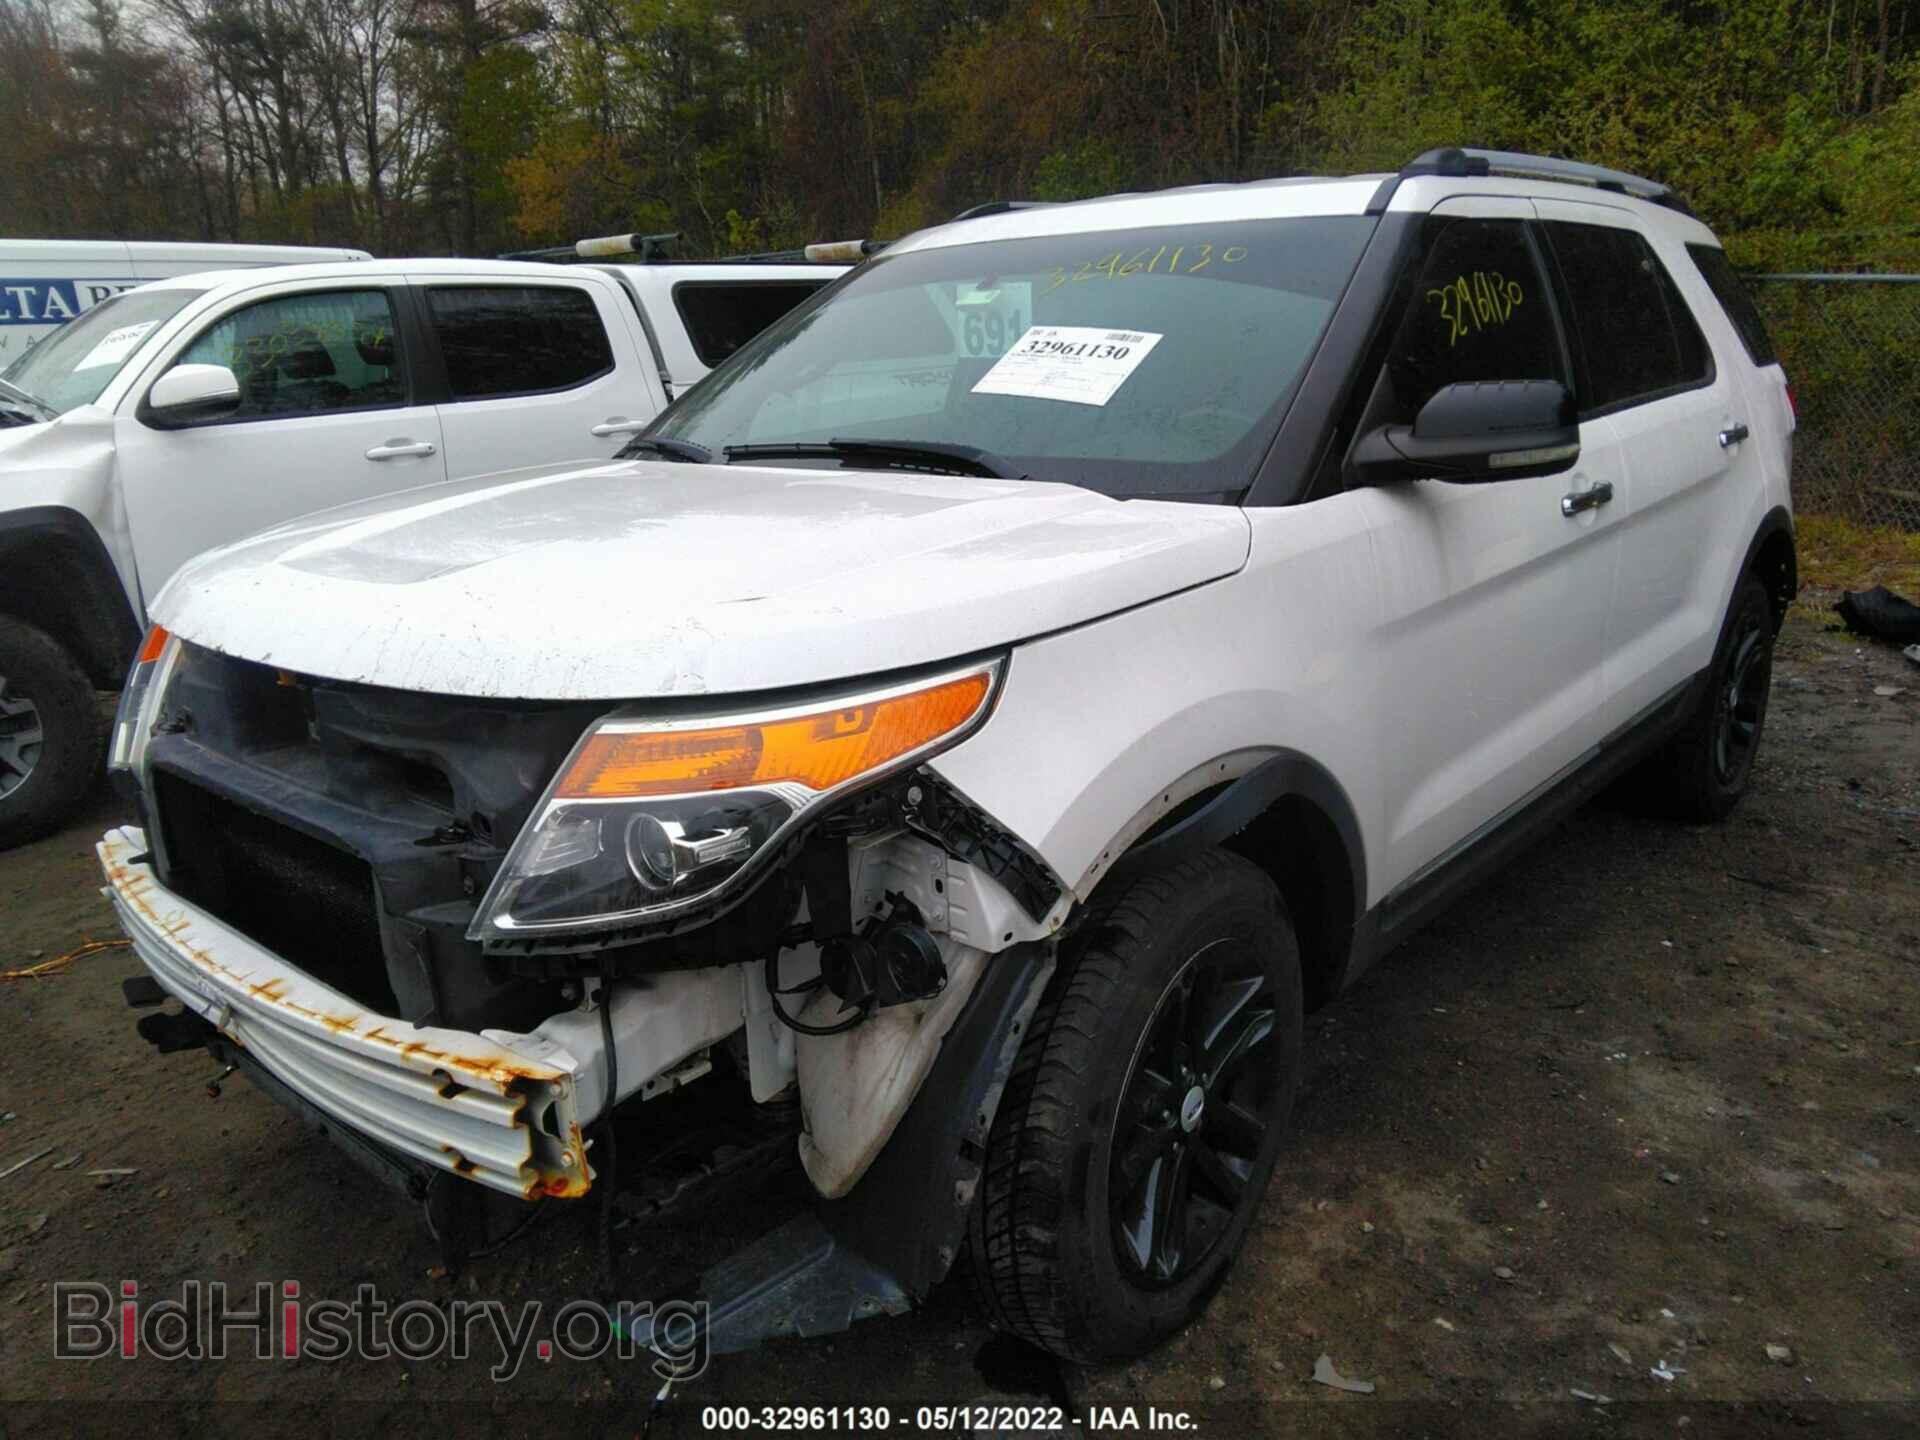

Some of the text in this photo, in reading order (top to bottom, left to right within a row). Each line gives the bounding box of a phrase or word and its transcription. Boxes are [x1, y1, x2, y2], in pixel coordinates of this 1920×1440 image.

[1040, 245, 1247, 295] 32961130
[1427, 271, 1522, 347] 32961130
[1021, 340, 1130, 360] 32961130
